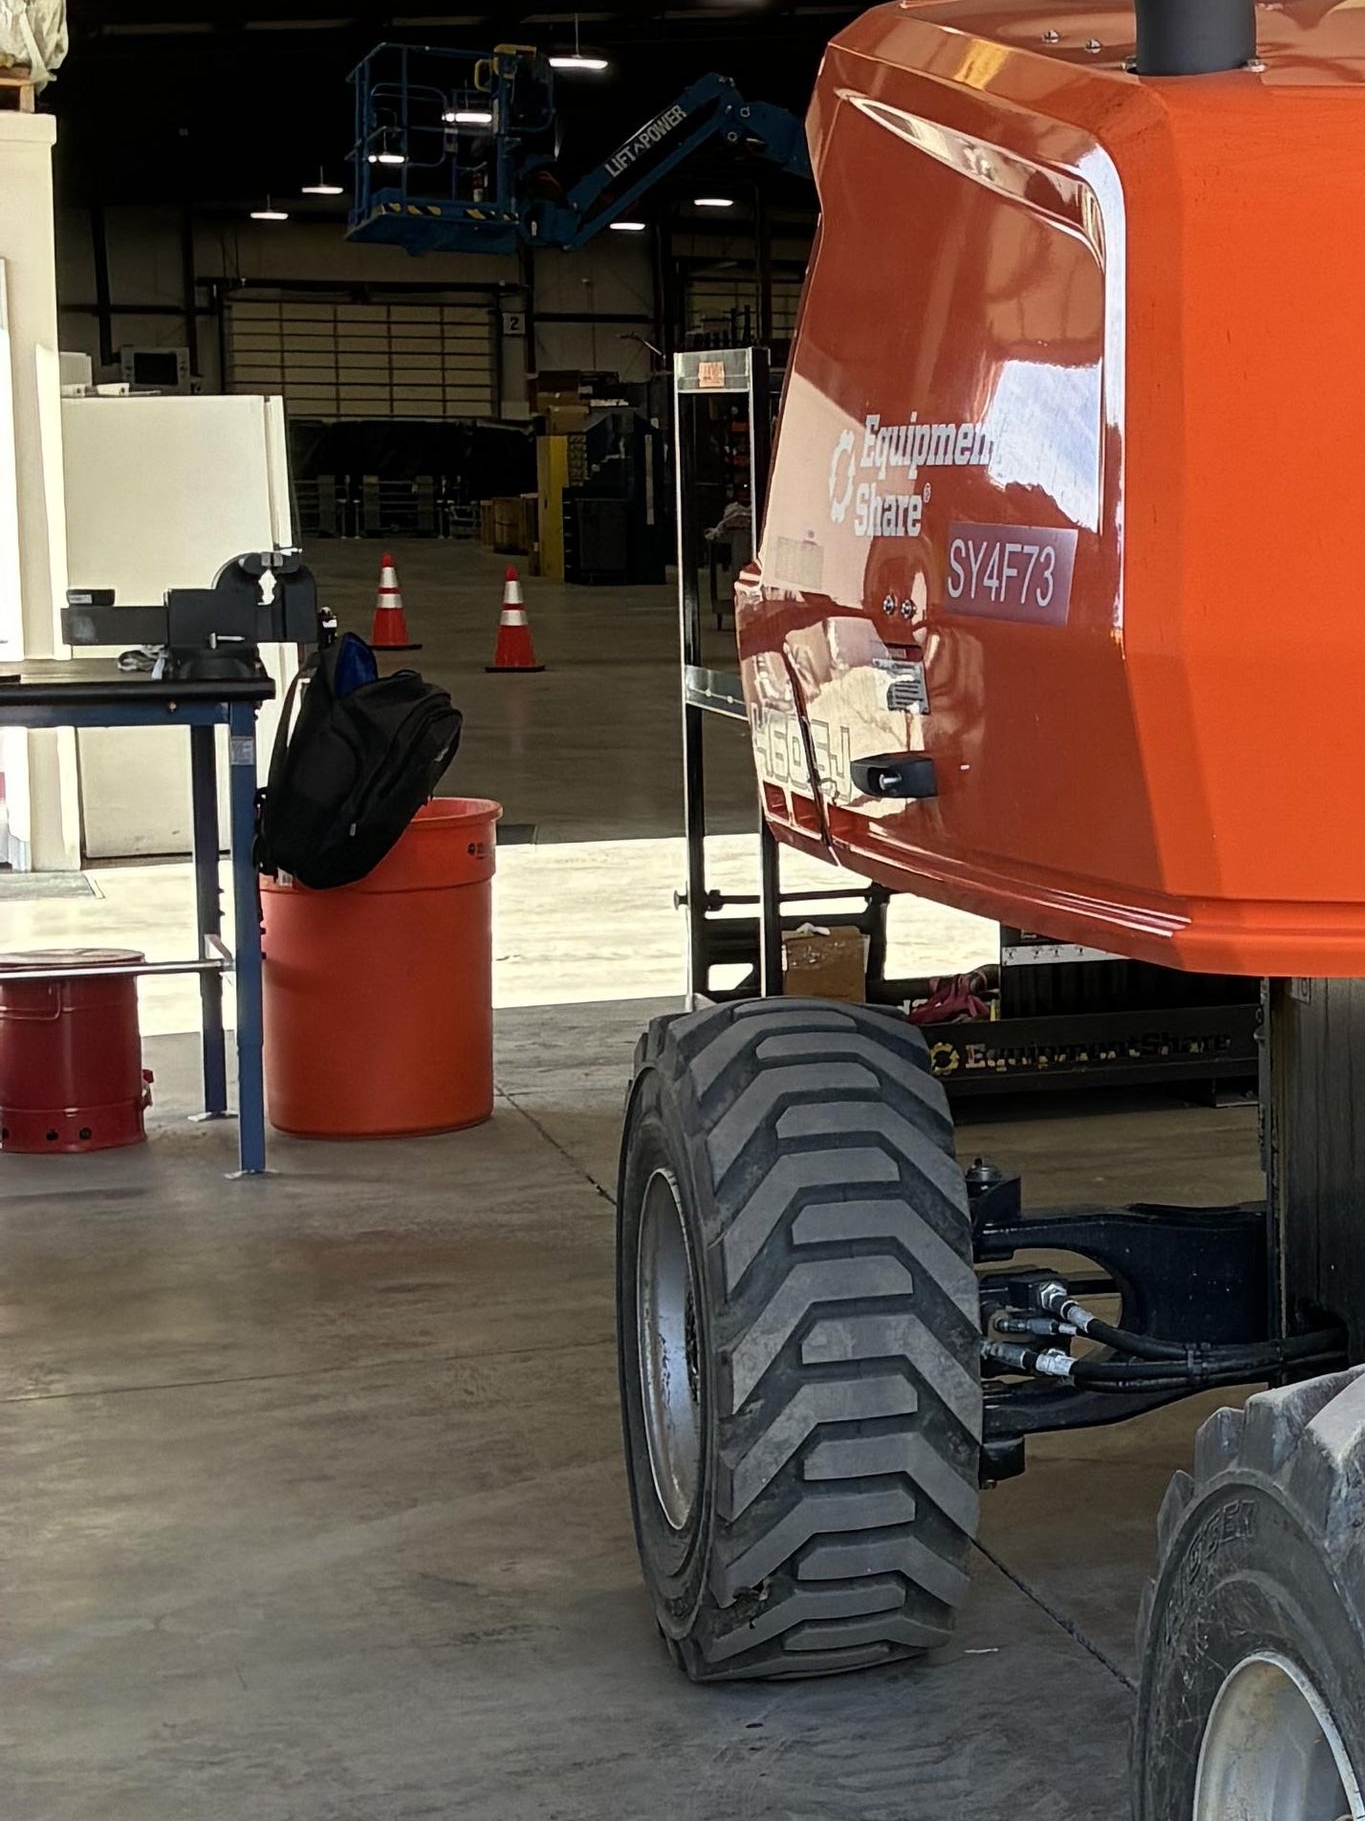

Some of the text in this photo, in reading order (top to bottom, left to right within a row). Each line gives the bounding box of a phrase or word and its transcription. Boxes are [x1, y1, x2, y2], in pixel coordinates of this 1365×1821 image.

[604, 104, 687, 177] LIFT POWER
[510, 316, 520, 330] 2
[947, 538, 1056, 607] SY4F73
